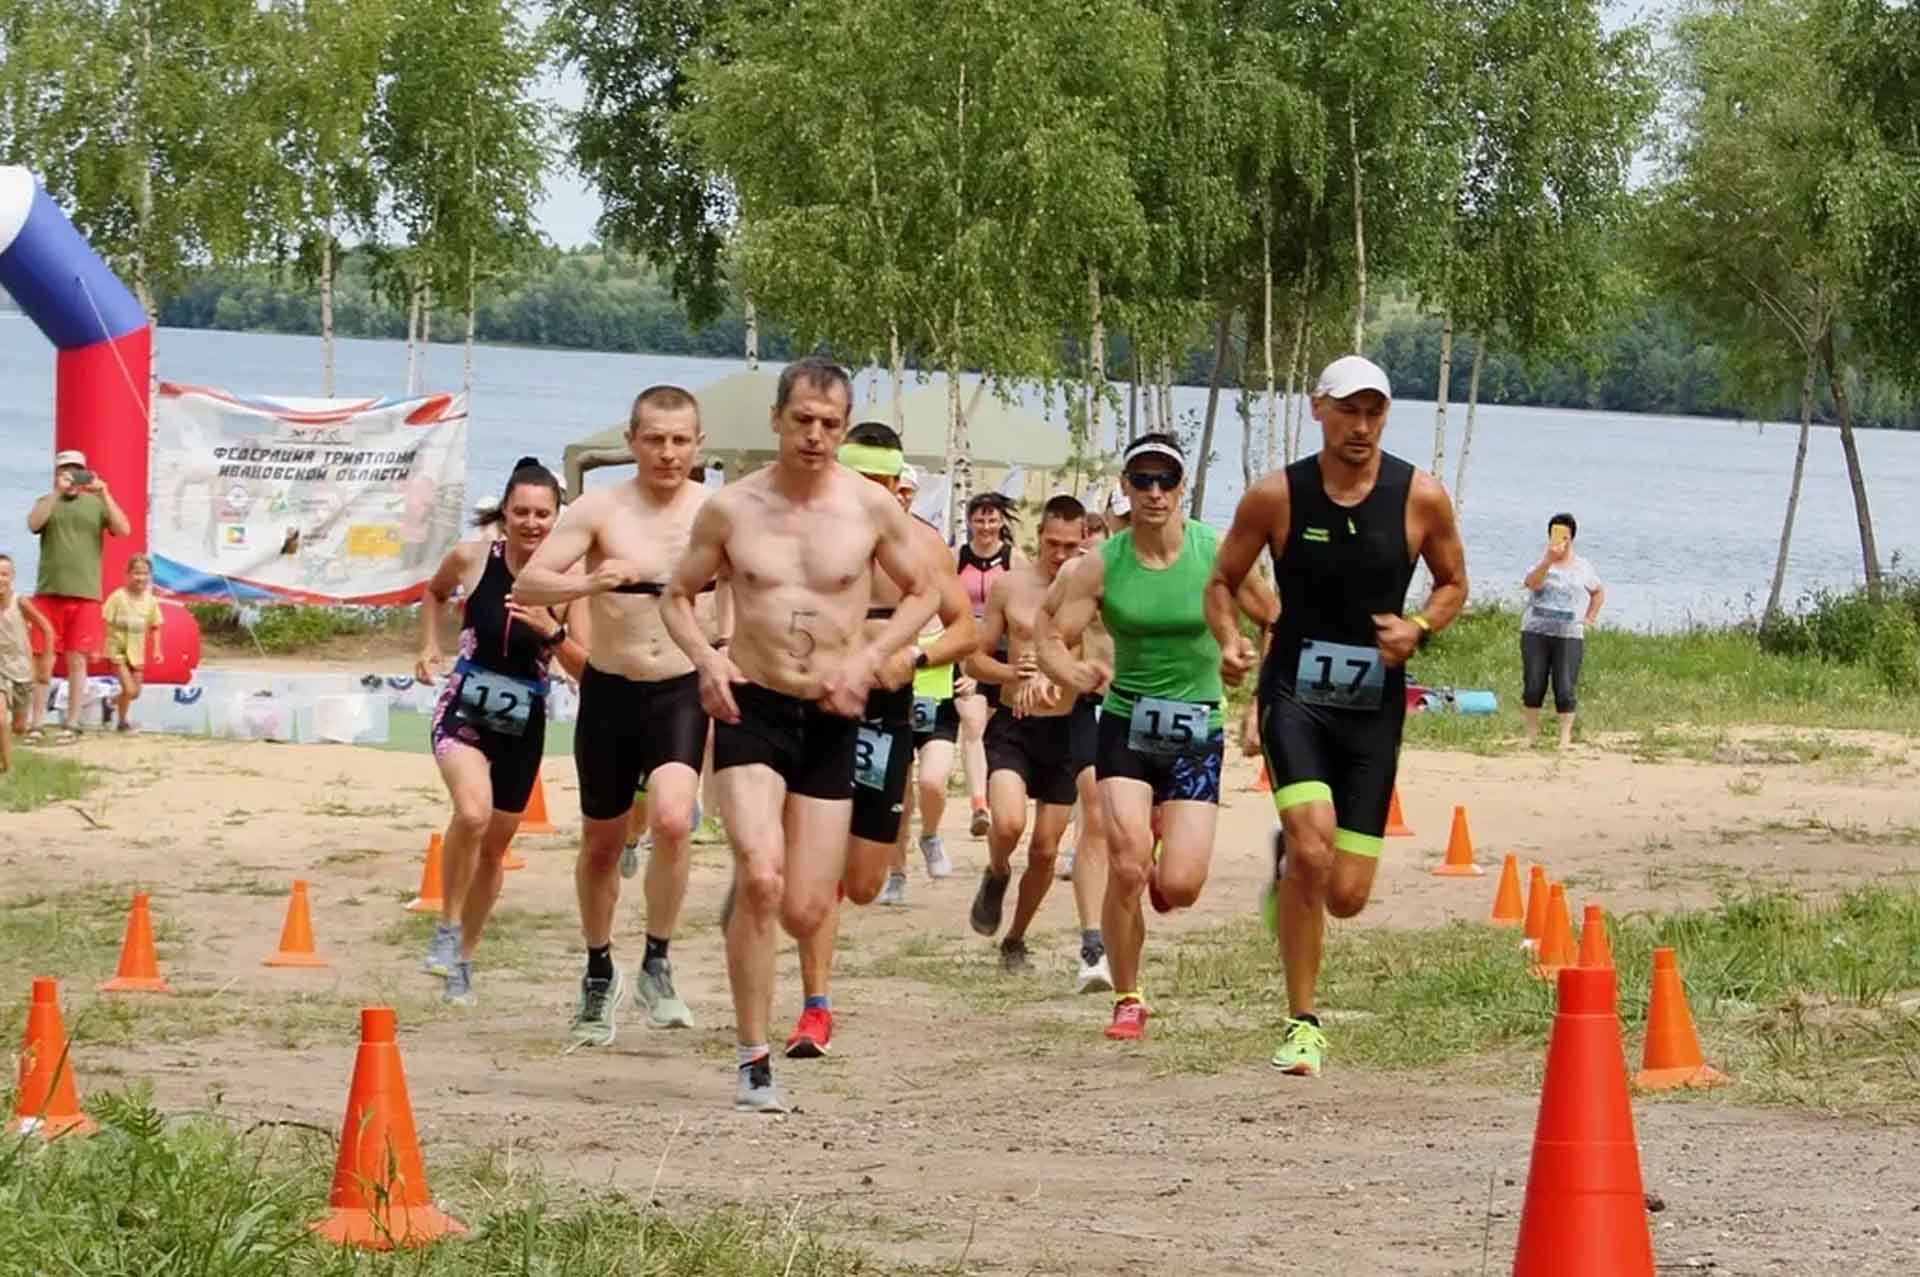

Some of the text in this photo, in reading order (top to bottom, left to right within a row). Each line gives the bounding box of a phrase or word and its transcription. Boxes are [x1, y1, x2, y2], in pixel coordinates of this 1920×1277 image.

[213, 446, 314, 464] ФЕДЕРАЦИЯ
[218, 464, 410, 481] ИВАНОВСКОЙ ОБЛАСТИ
[788, 610, 819, 659] 5
[1314, 655, 1371, 695] 17
[475, 685, 518, 718] 12
[1143, 709, 1193, 743] 15
